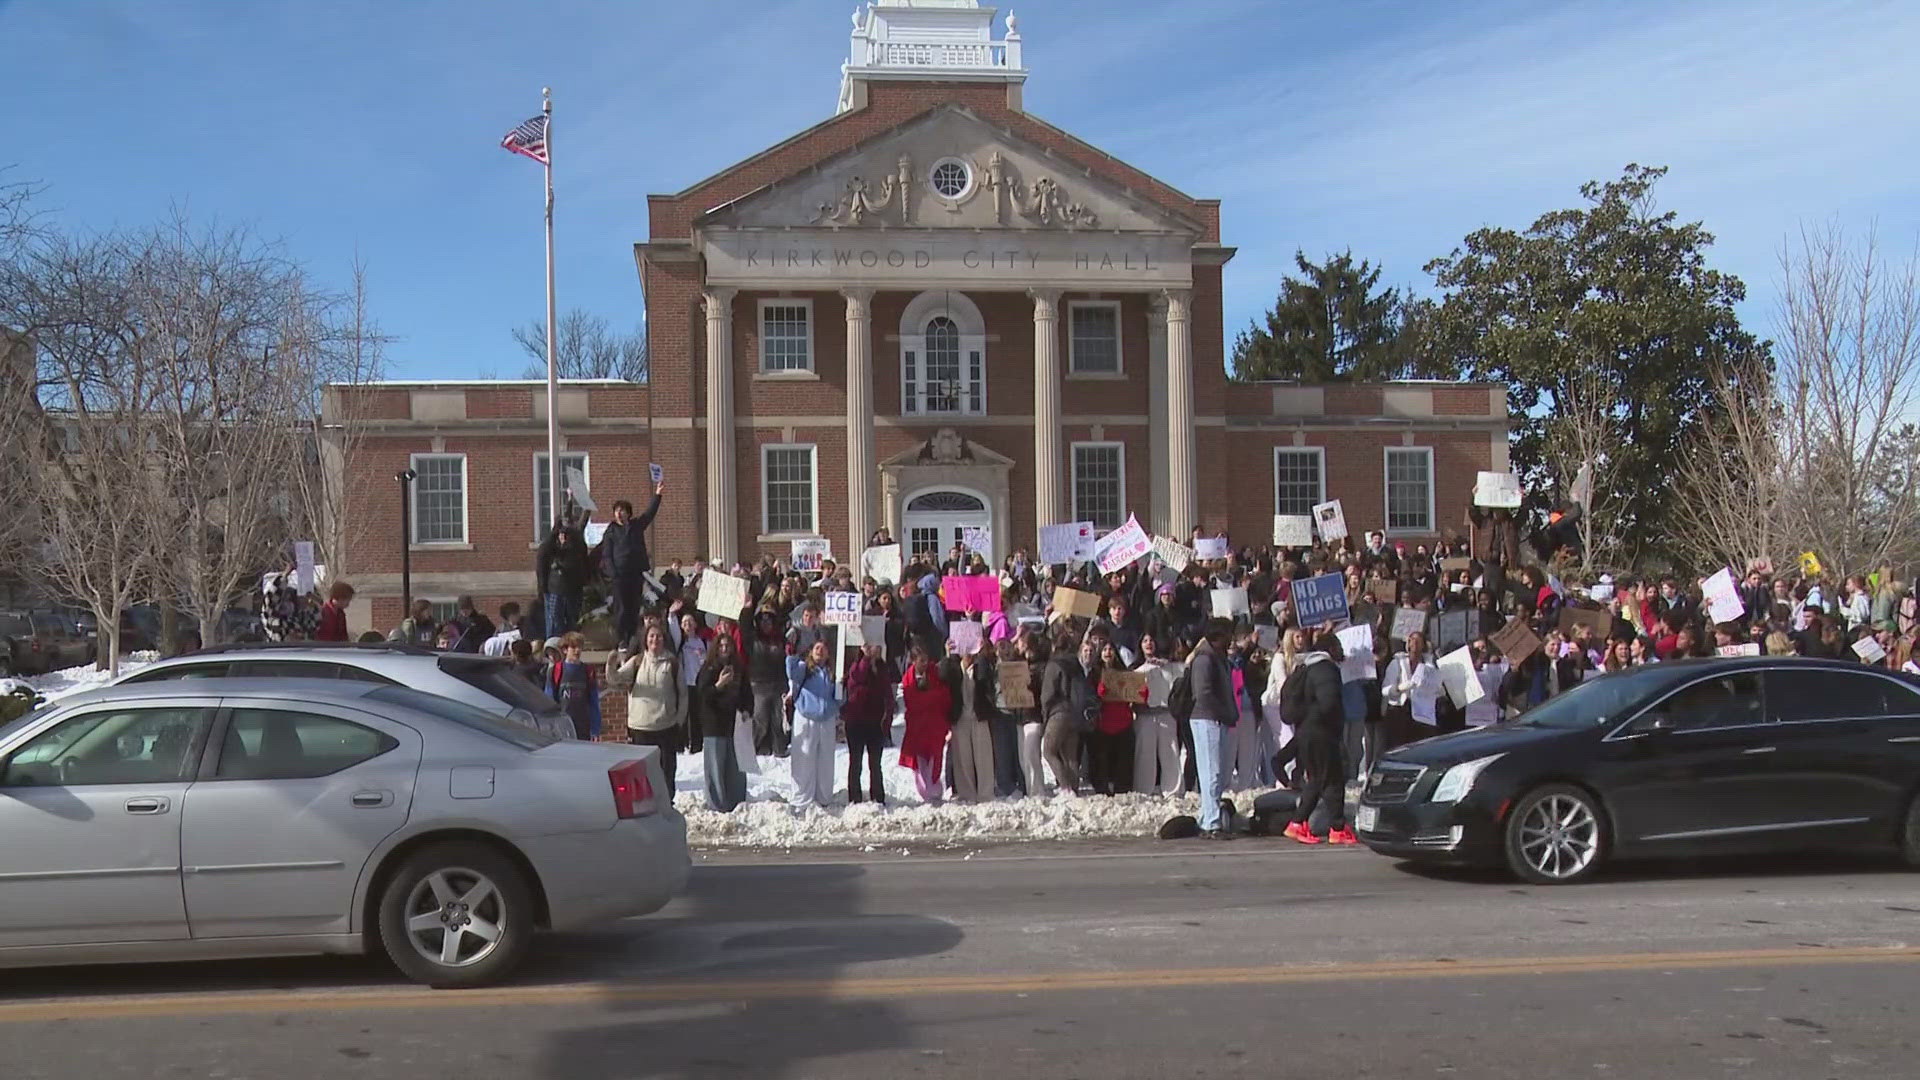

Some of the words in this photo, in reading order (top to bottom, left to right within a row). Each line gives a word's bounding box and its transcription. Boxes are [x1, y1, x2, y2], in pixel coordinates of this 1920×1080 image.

[747, 249, 931, 269] KIRKWOOD
[963, 250, 1041, 269] CITY
[1075, 252, 1158, 270] HALL
[797, 553, 822, 561] YOUR
[1295, 581, 1317, 600] NO
[826, 593, 856, 612] ICE
[1299, 594, 1342, 616] KINGS
